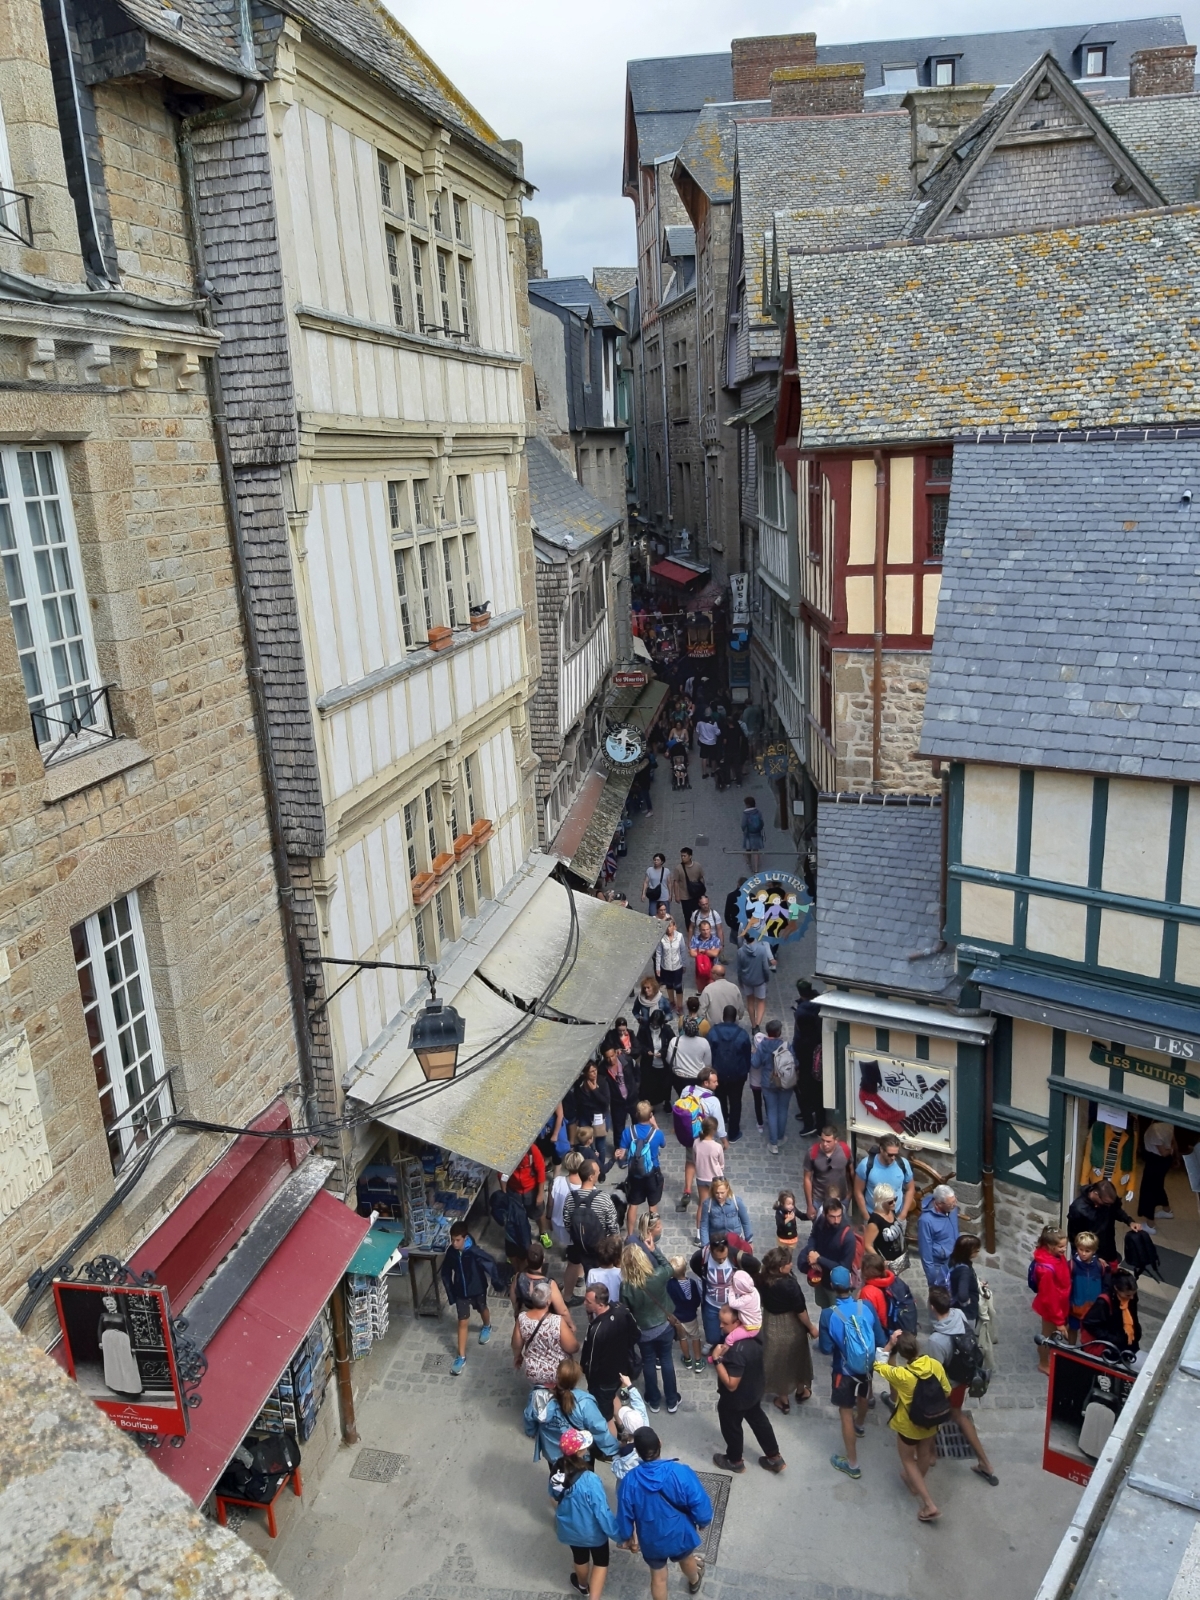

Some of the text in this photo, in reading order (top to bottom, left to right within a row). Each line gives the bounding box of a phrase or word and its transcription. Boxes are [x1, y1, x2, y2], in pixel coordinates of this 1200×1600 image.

[742, 873, 806, 894] LES LUTINS
[1153, 1034, 1194, 1058] LES
[1104, 1053, 1187, 1086] LES LUTINS
[900, 1089, 924, 1101] JAMES
[120, 1419, 159, 1431] Boutique
